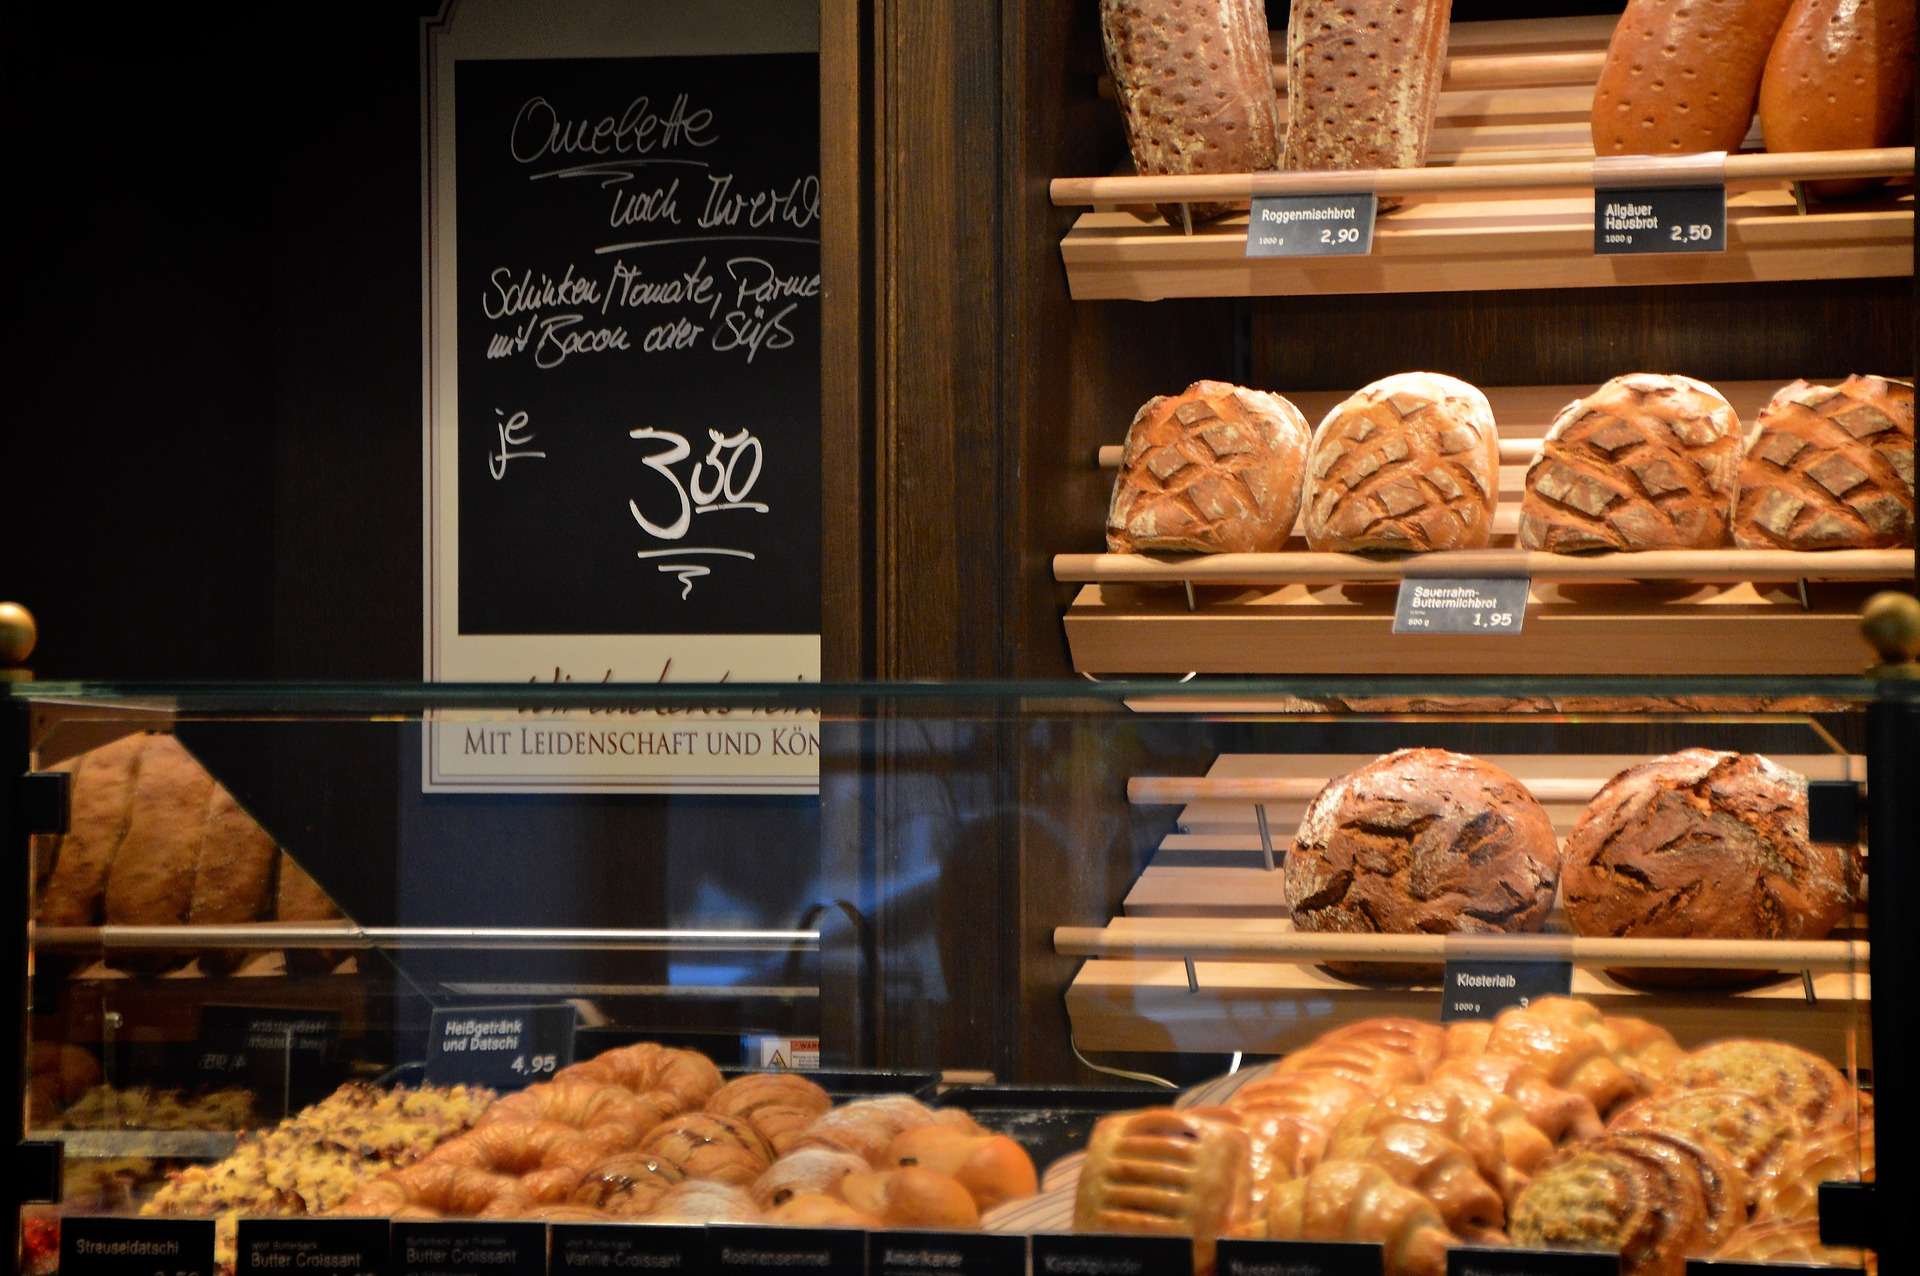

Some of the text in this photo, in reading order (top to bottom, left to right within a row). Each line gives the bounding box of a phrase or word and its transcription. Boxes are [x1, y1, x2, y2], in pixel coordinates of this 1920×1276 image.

[610, 178, 680, 228] nach
[1605, 203, 1653, 219] Allgäuer
[1261, 207, 1356, 224] Roggenmischbrot
[1605, 217, 1658, 230] Hausbrot
[1320, 228, 1360, 246] 2,90
[1670, 224, 1712, 243] 2,50
[534, 314, 632, 369] Bacon
[643, 317, 704, 352] oder
[489, 407, 536, 481] je
[1414, 586, 1480, 598] Sauerrahm-
[1412, 597, 1497, 609] Buttermilchbrot
[1472, 612, 1513, 629] 1,95
[1456, 973, 1516, 988] Klosterlaib
[1454, 1002, 1474, 1012] 1000
[445, 1020, 522, 1037] Heißgetränk
[443, 1037, 517, 1052] und Datschi
[511, 1056, 556, 1075] 4,95
[76, 1237, 180, 1256] Streuseldatschi
[250, 1250, 363, 1269] Butter Croissant
[405, 1247, 518, 1265] Butter Croissant
